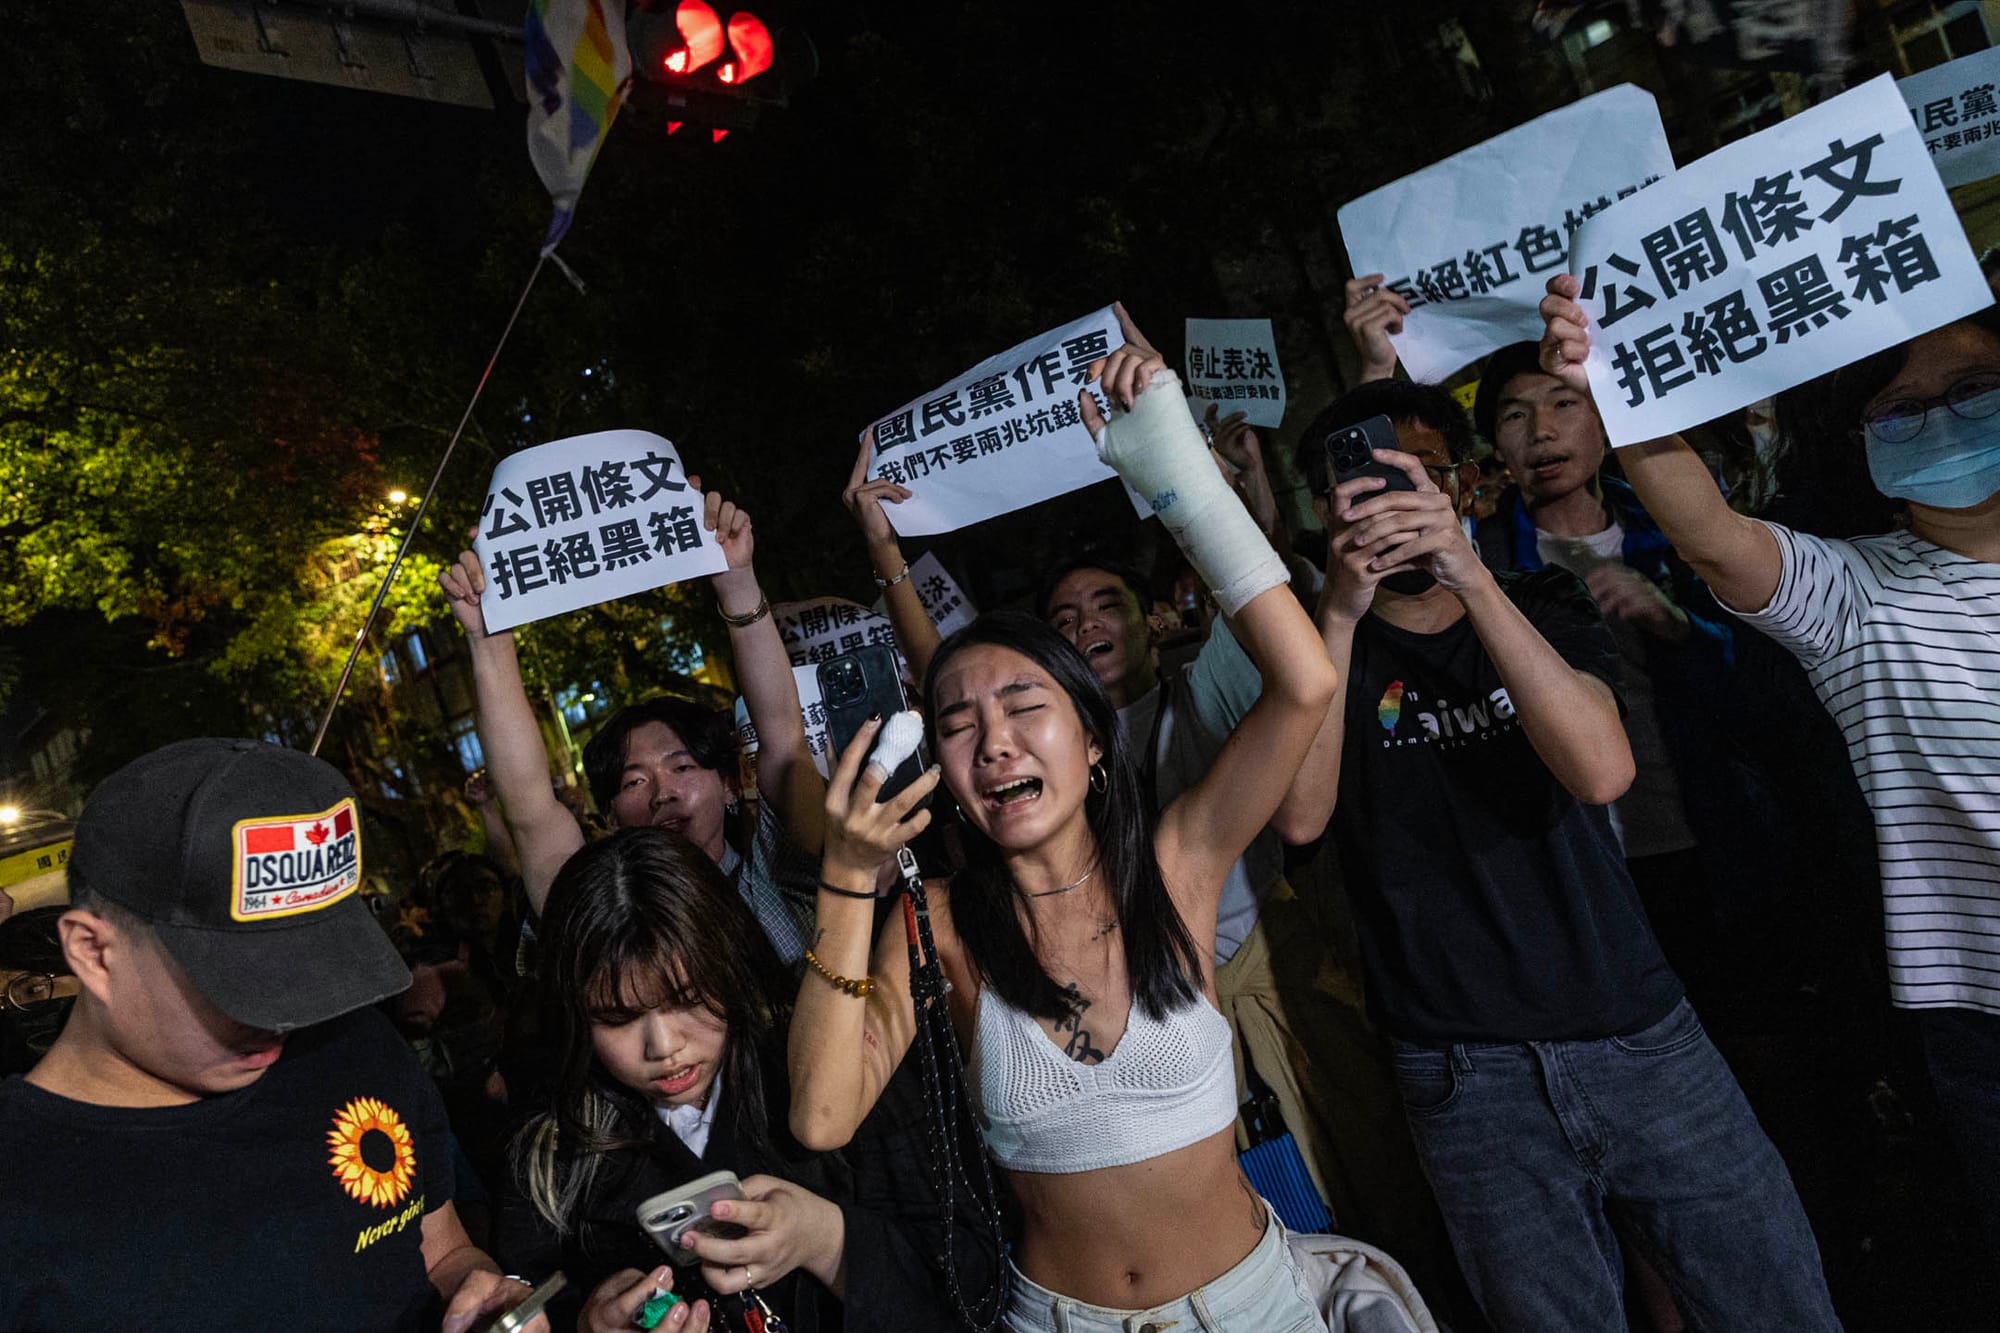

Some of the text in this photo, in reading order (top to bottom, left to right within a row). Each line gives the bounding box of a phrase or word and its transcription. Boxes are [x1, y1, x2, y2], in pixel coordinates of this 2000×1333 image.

[1910, 83, 2000, 133] 民黨
[1386, 174, 1665, 308] 拒絕紅色
[1579, 133, 1903, 329] 公開條文
[1612, 214, 1940, 408] 拒絕黑箱
[873, 329, 1108, 456] 國民黨作票
[1189, 345, 1276, 380] 停止表決
[877, 392, 1111, 484] 我們不要兩兆坑錢
[483, 451, 686, 540] 公開條文
[491, 505, 703, 601] 拒絕黑箱
[355, 1215, 398, 1253] Never
